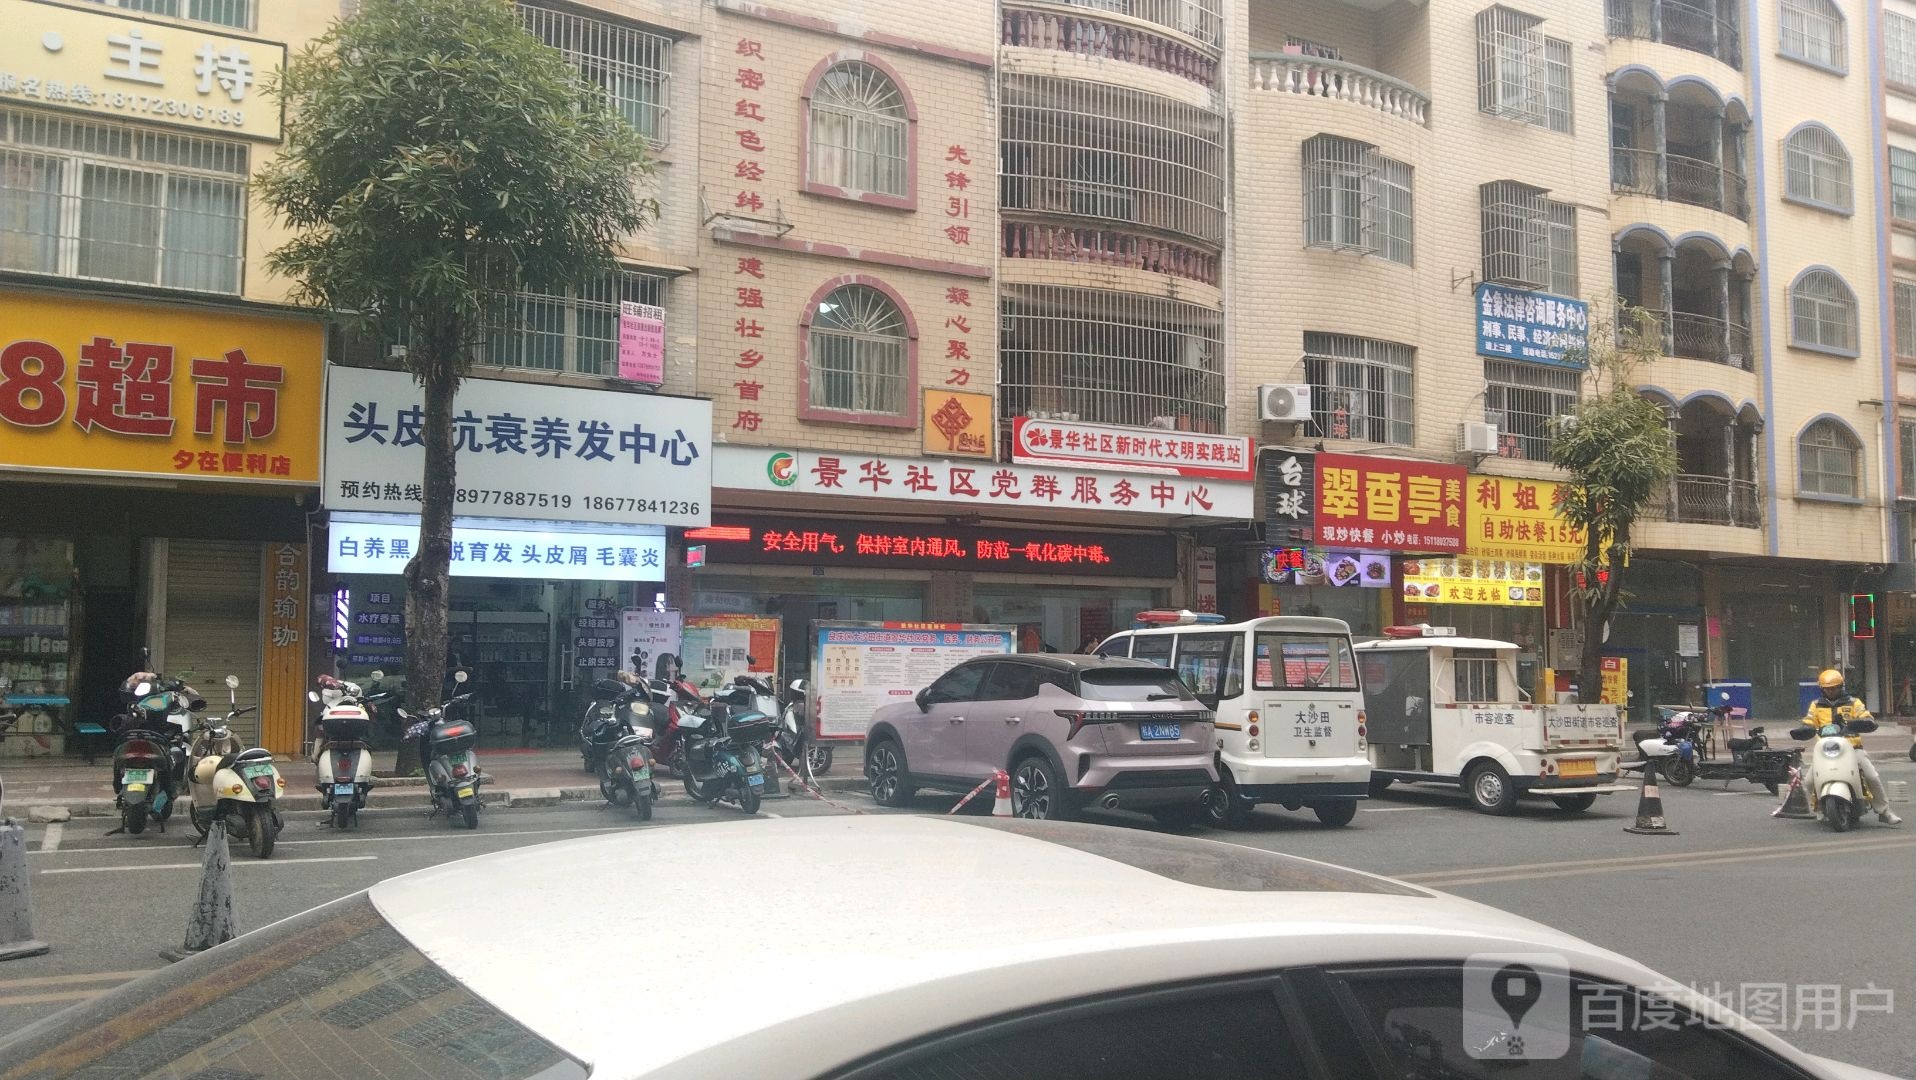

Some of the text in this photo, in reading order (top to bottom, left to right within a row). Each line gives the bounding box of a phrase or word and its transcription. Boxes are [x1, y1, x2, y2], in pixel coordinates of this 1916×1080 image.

[734, 37, 766, 213] 织密红色经纬
[943, 144, 972, 246] 先锋引领
[622, 303, 663, 320] 旺铺招租
[733, 256, 765, 432] 建强壮乡首府
[945, 286, 972, 386] 凝心聚力
[344, 402, 700, 466] 头皮抗衰养发中心
[1048, 428, 1241, 465] 景华社区新时代文明实践站
[172, 450, 291, 475] 夕在便利店
[456, 488, 572, 509] 8977887519
[583, 495, 700, 516] 18677841236
[810, 456, 1214, 511] 景华社区党群服务中心
[1276, 455, 1309, 520] 台球
[1322, 466, 1442, 525] 翠香亭
[1446, 478, 1461, 528] 美食
[339, 537, 411, 559] 白养黑
[521, 546, 588, 566] 头皮屑
[596, 547, 660, 568] 毛囊炎
[1322, 526, 1375, 543] 现炒快餐
[1381, 530, 1405, 545] 小炒
[1449, 586, 1501, 601] 欢迎光临
[1293, 726, 1332, 737] 卫生监督
[1296, 711, 1330, 724] 大沙田
[1474, 712, 1515, 725] 市容巡查
